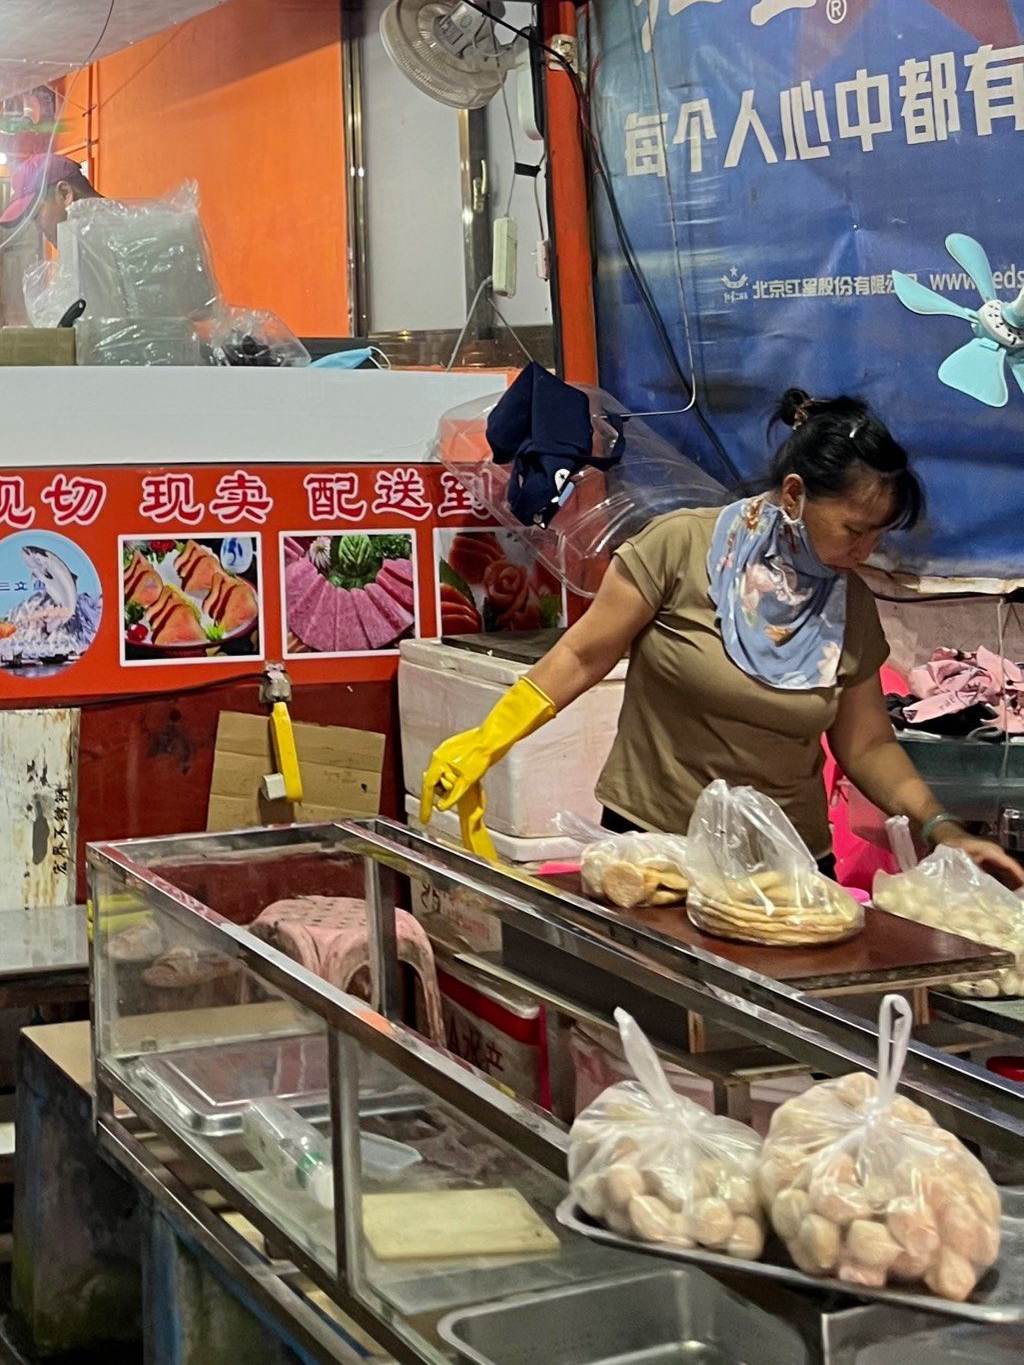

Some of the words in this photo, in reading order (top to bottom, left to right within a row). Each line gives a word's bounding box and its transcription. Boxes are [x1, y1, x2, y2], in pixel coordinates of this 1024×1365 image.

[624, 43, 1024, 178] 每个人心中都有
[752, 273, 918, 300] 北京红星股份有限公
[139, 470, 274, 526] 现卖
